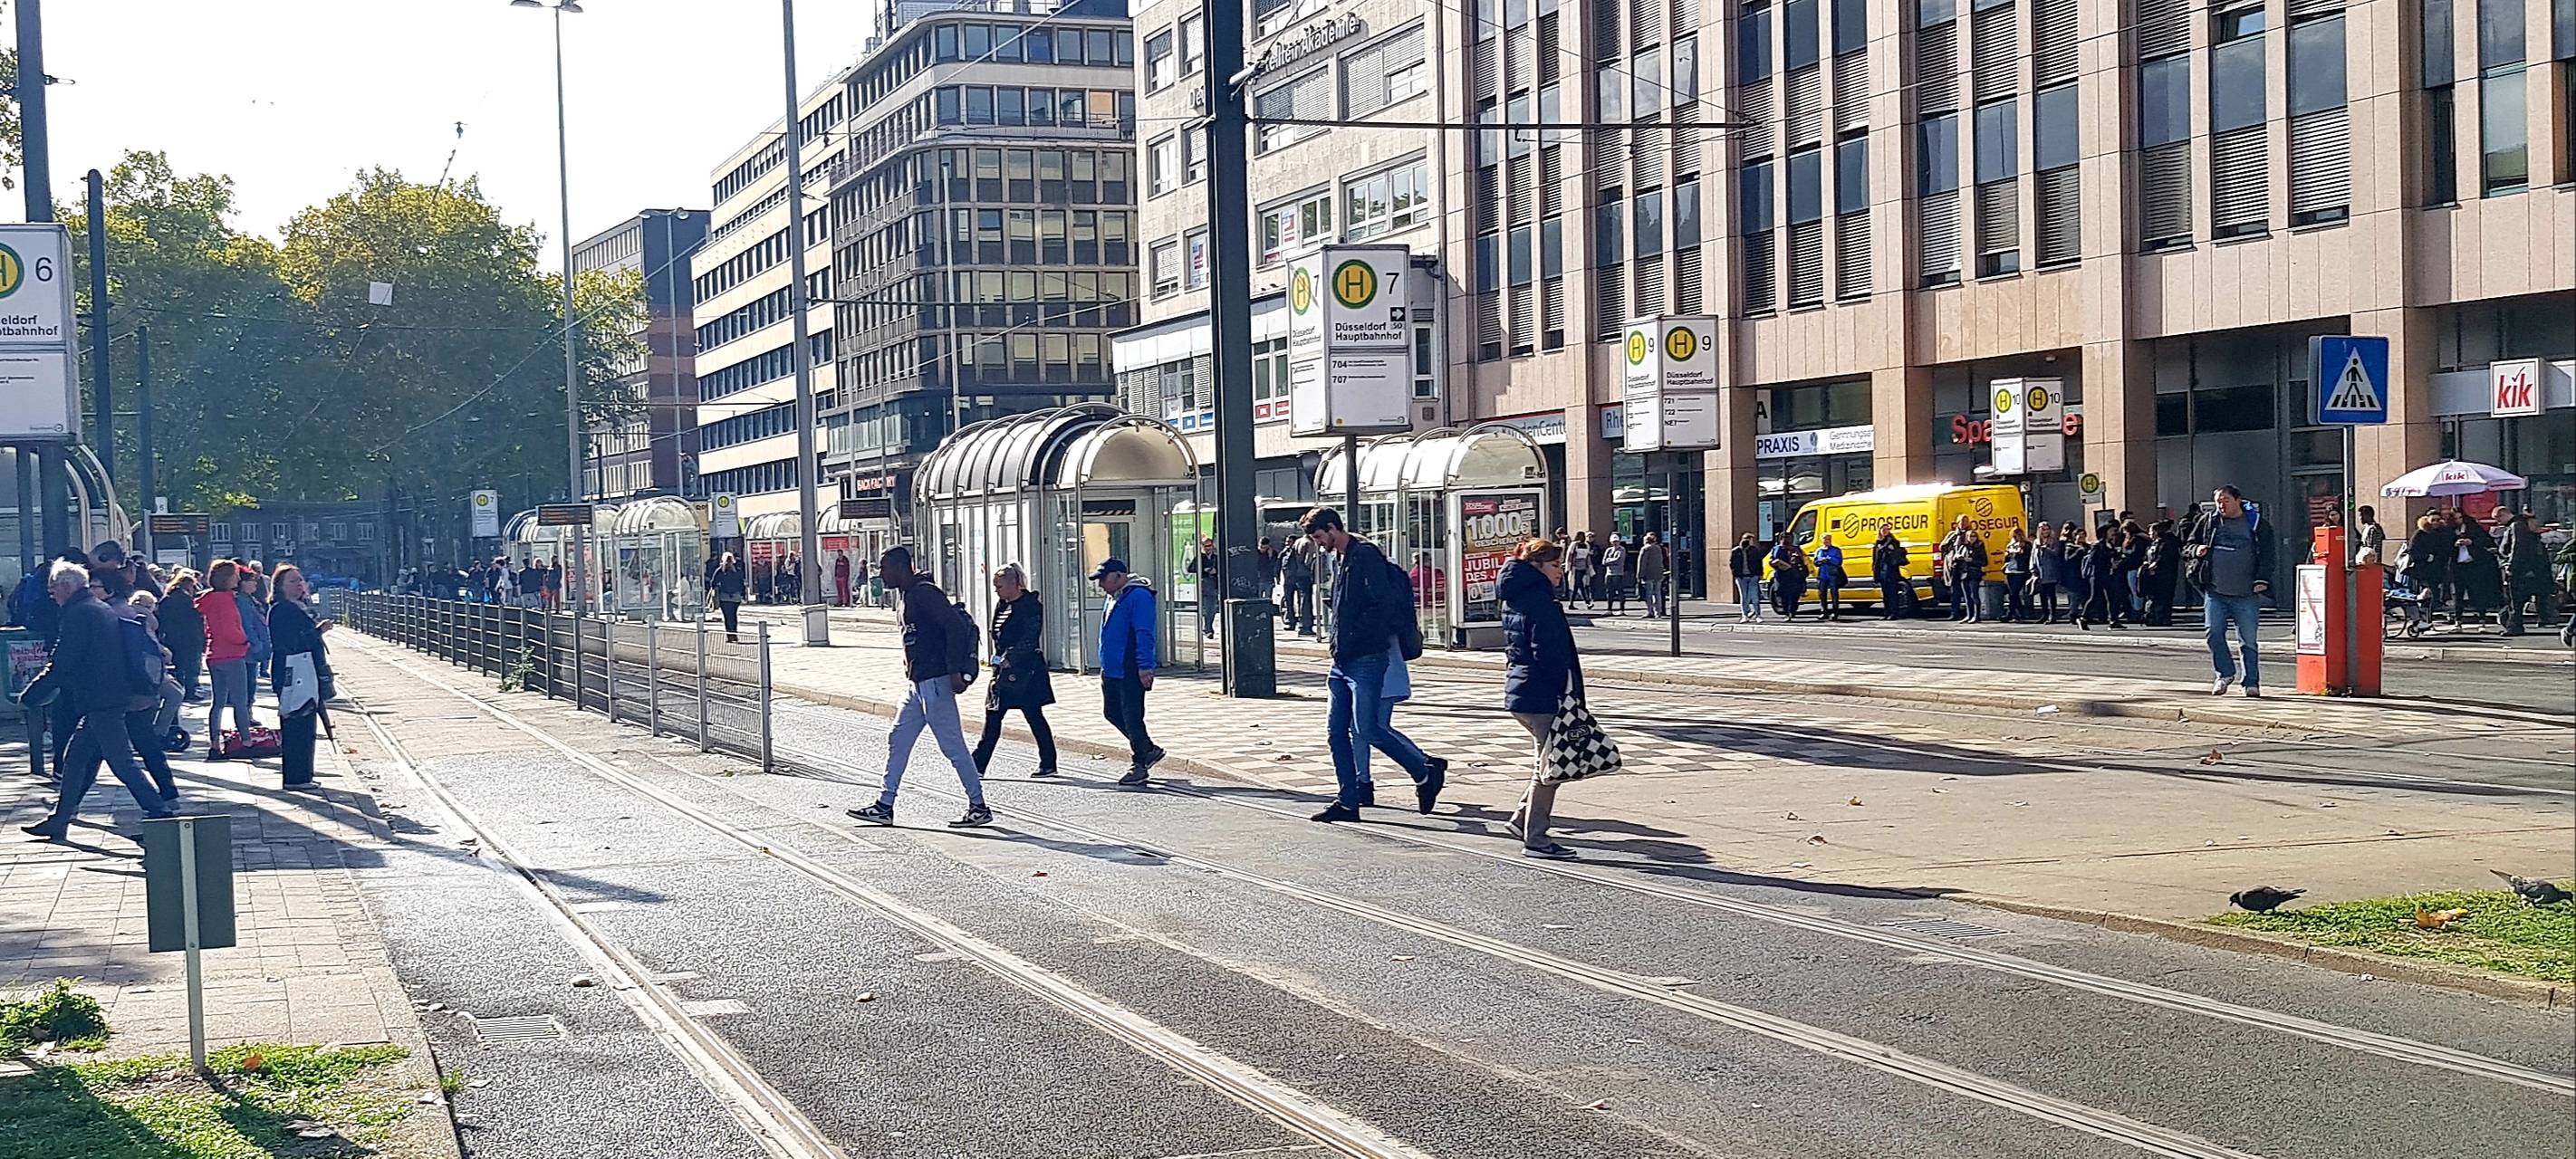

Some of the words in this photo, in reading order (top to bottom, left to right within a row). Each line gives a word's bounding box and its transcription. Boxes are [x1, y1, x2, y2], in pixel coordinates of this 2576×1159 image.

[35, 257, 53, 283] 6
[1385, 273, 1399, 295] 7
[0, 315, 38, 325] eldorf
[1335, 321, 1387, 331] Düsseldorf
[1335, 331, 1402, 342] Hauptbahnhof
[1701, 335, 1712, 351] 9
[1648, 337, 1655, 353] 9
[1332, 360, 1348, 369] 704
[1332, 376, 1348, 384] 707
[2496, 366, 2533, 409] kik
[2049, 392, 2061, 404] 10
[1757, 436, 1800, 455] PRAXIS
[2446, 473, 2465, 481] kik
[1951, 517, 2019, 532] POSEGUR
